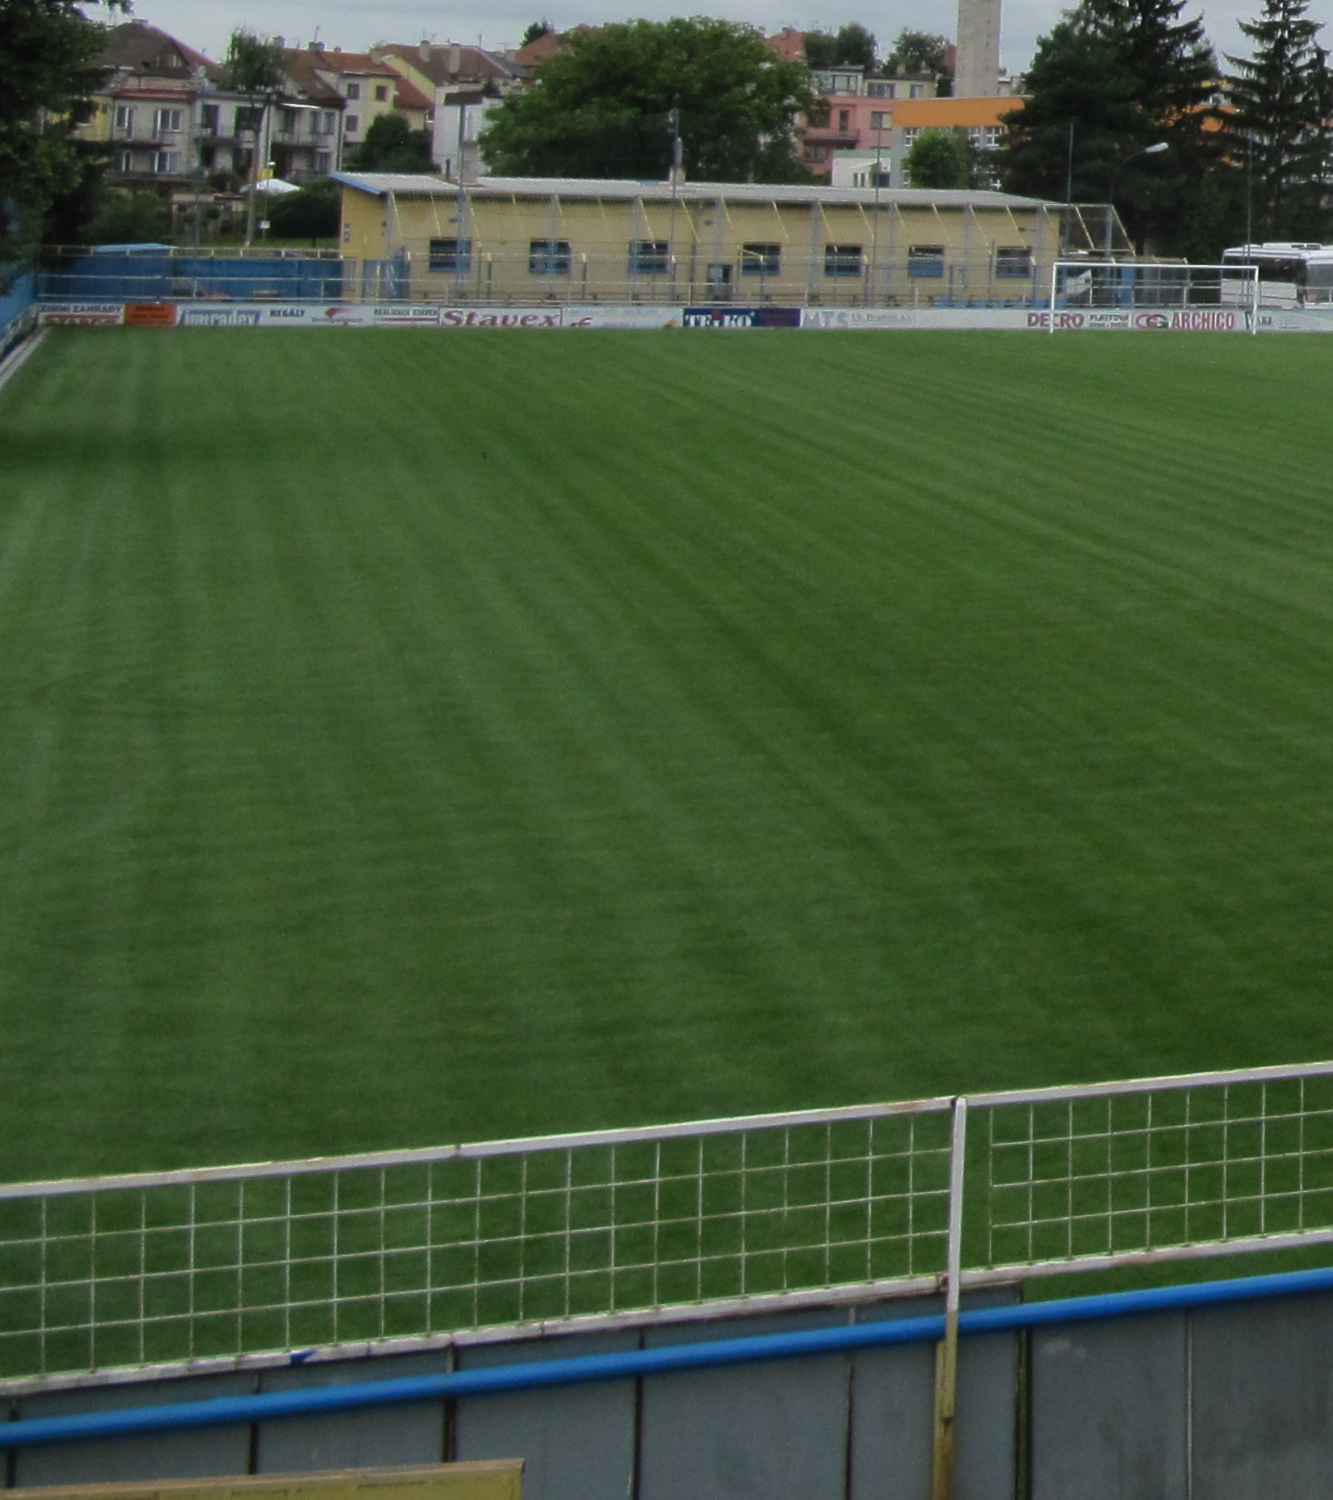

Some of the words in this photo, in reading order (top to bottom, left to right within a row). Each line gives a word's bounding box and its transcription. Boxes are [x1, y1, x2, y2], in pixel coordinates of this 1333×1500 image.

[441, 310, 559, 327] Stavex
[1027, 312, 1084, 328] DECRO
[1172, 312, 1235, 329] ARCHICO
